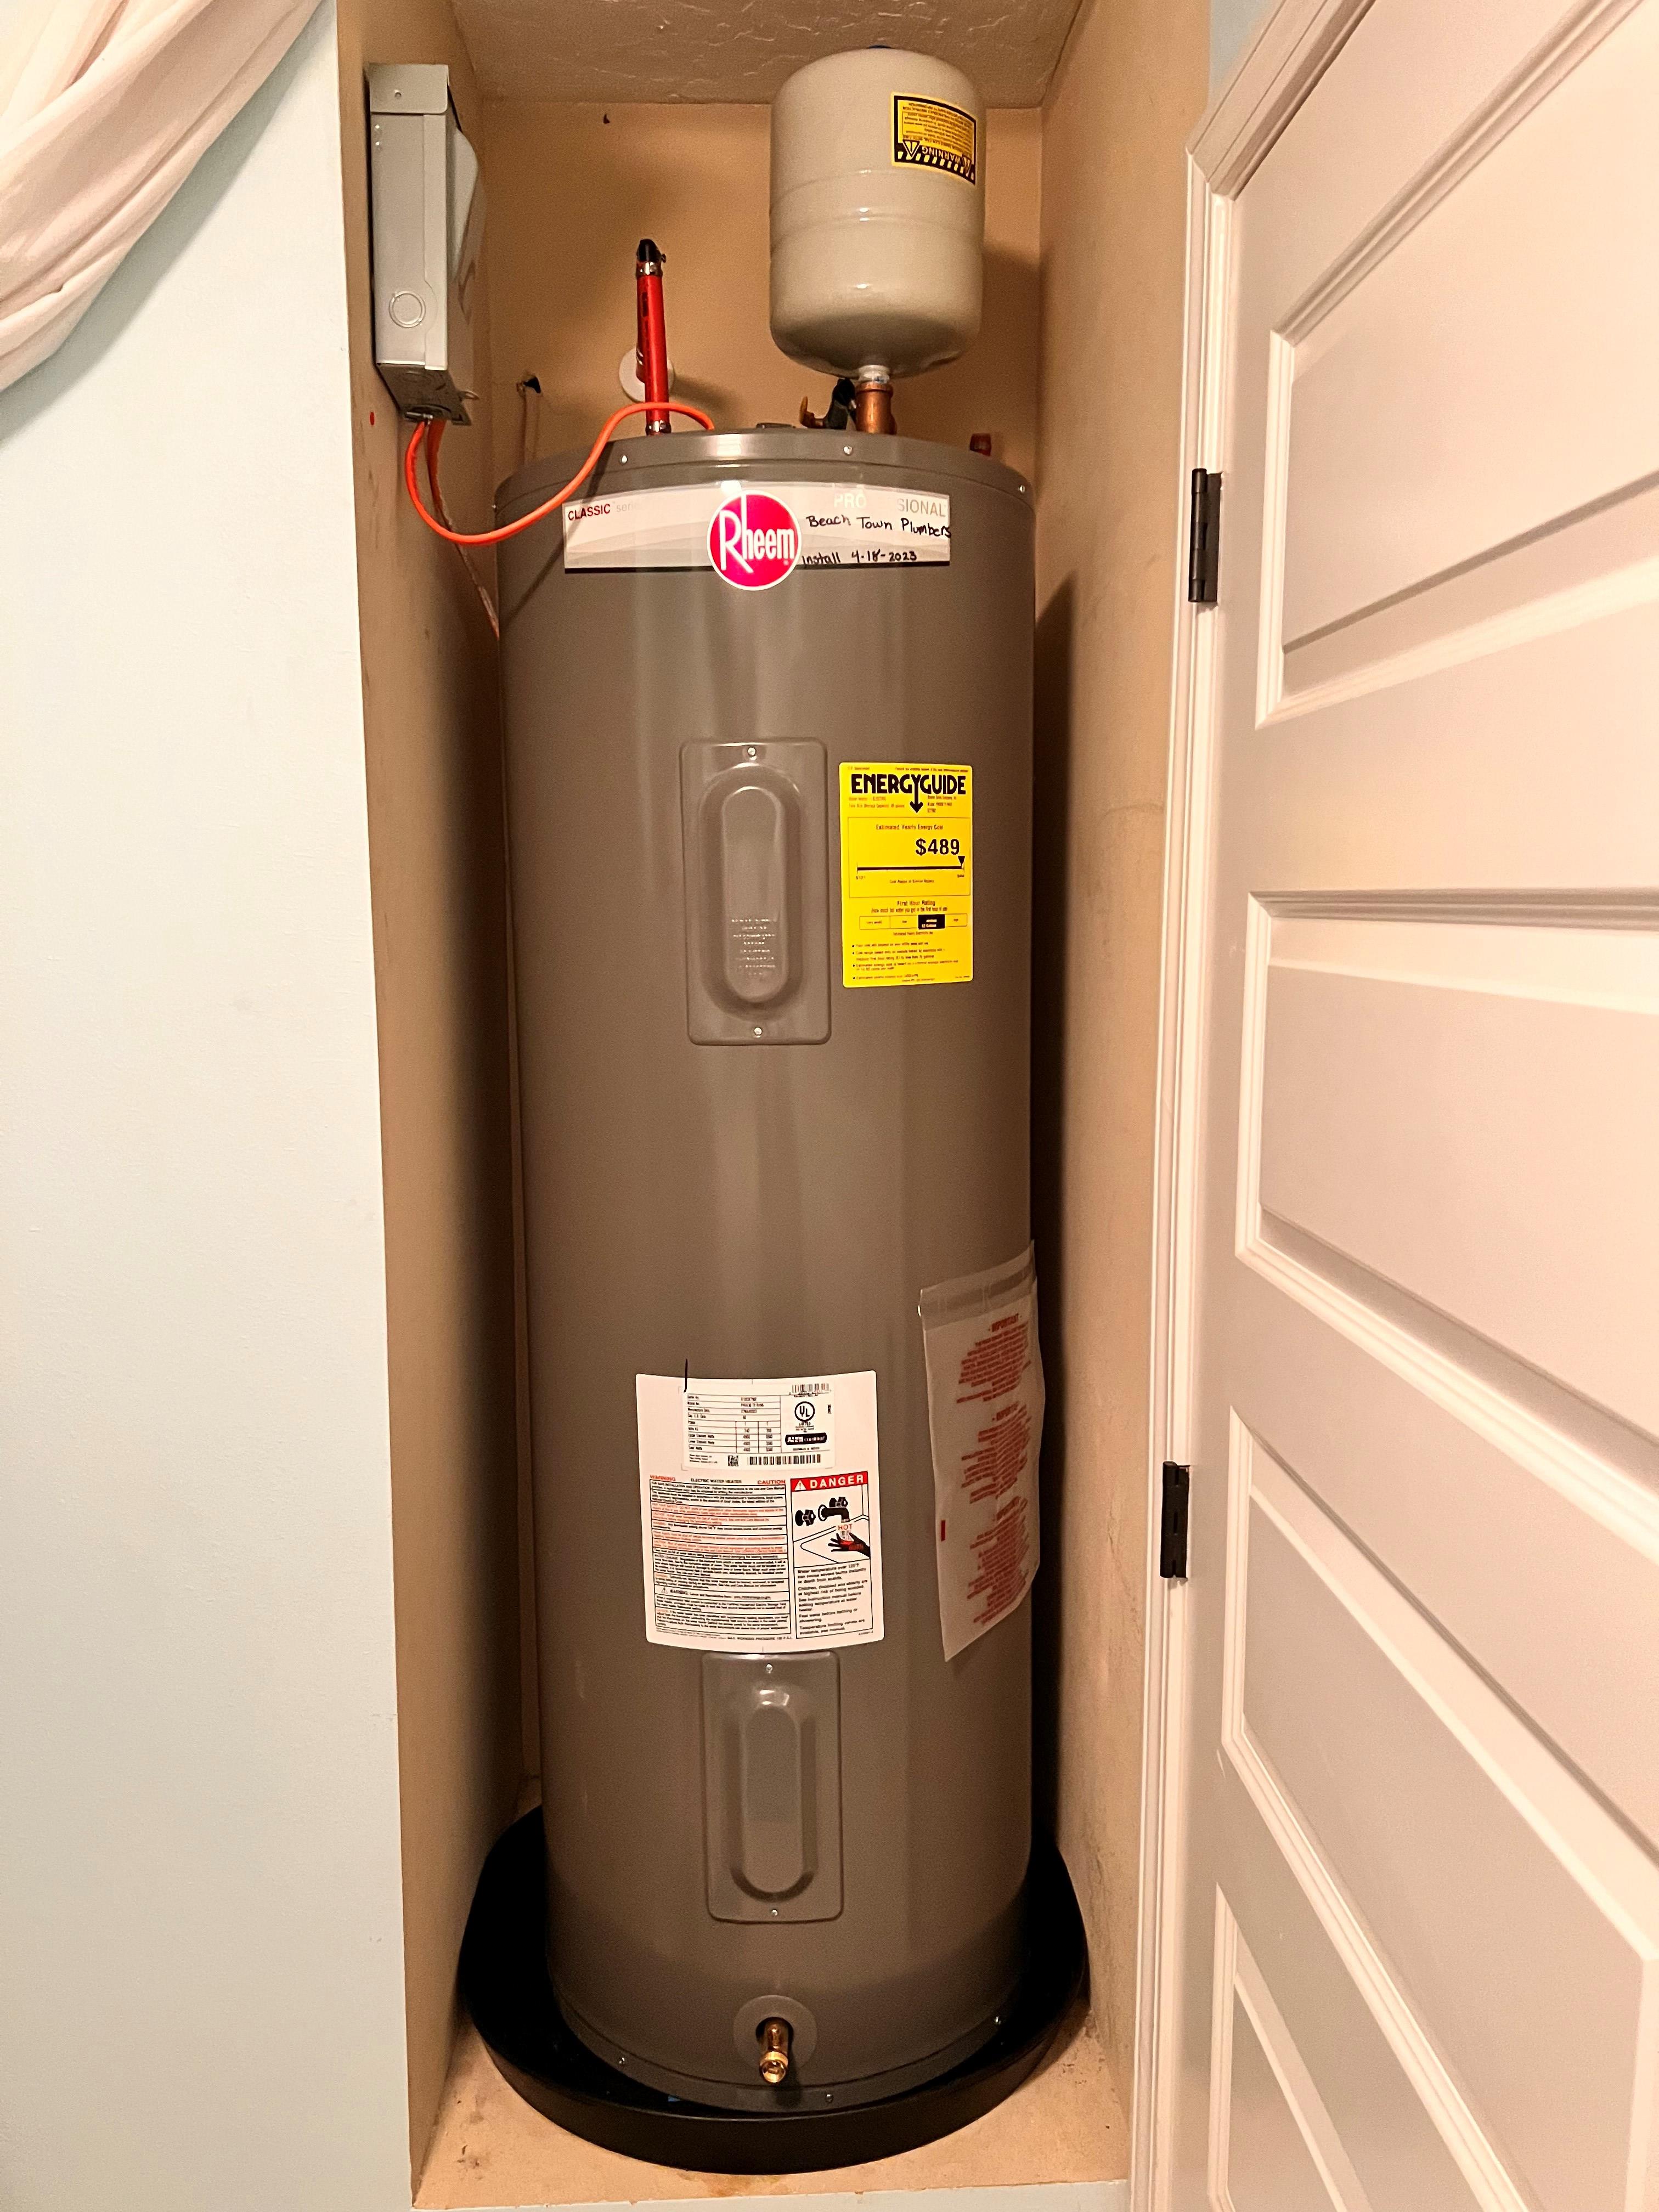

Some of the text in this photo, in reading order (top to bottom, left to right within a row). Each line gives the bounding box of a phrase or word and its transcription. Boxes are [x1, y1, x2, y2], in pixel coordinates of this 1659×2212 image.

[922, 146, 961, 164] WARNING
[568, 503, 611, 521] CLASSIC
[719, 493, 795, 573] Rheem
[806, 514, 951, 538] Beach Town Plumbers
[851, 774, 966, 794] ENERGYGUIDE
[915, 838, 960, 856] $489
[810, 1474, 864, 1489] DANGER
